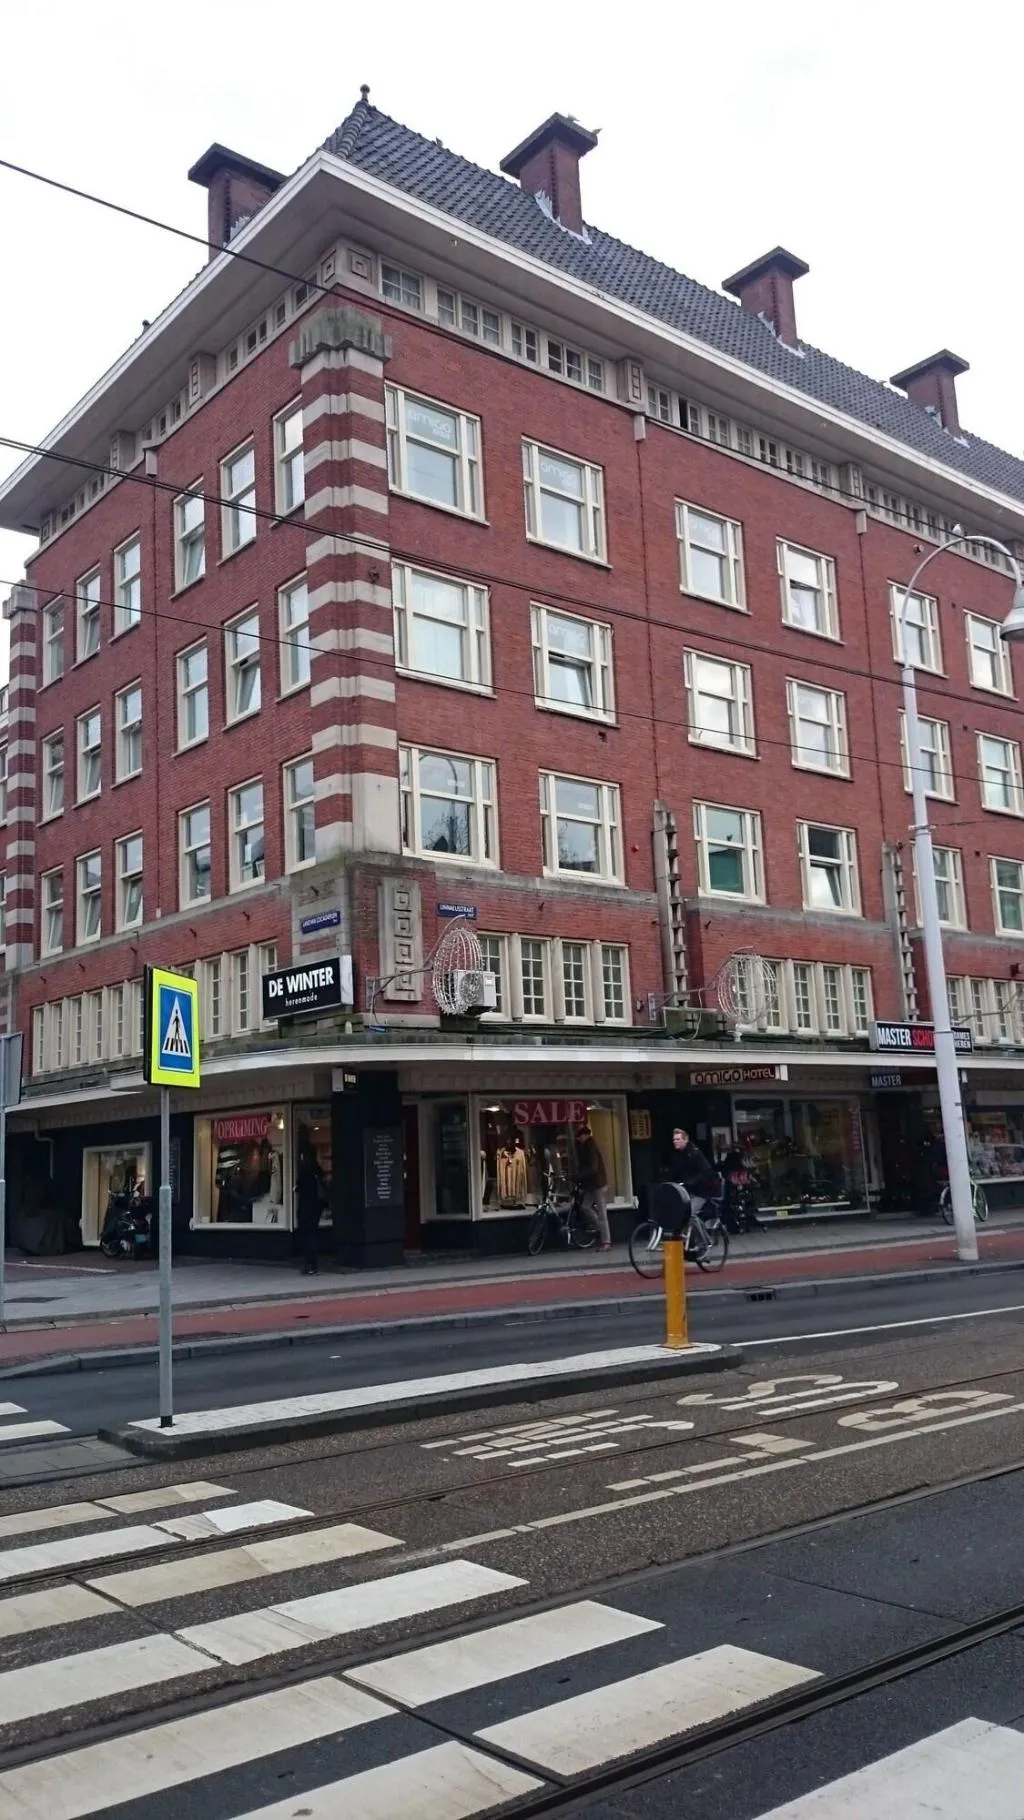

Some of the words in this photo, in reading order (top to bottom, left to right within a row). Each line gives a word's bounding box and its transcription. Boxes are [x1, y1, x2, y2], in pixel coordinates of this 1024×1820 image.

[268, 978, 284, 998] DE
[286, 966, 335, 994] WINTER
[285, 992, 318, 1007] herenmode
[878, 1027, 912, 1046] MASTER
[743, 1067, 775, 1080] HOTEL
[871, 1074, 902, 1087] MASTER
[514, 1100, 585, 1124] SALE
[217, 1117, 268, 1138] OPRUIMING
